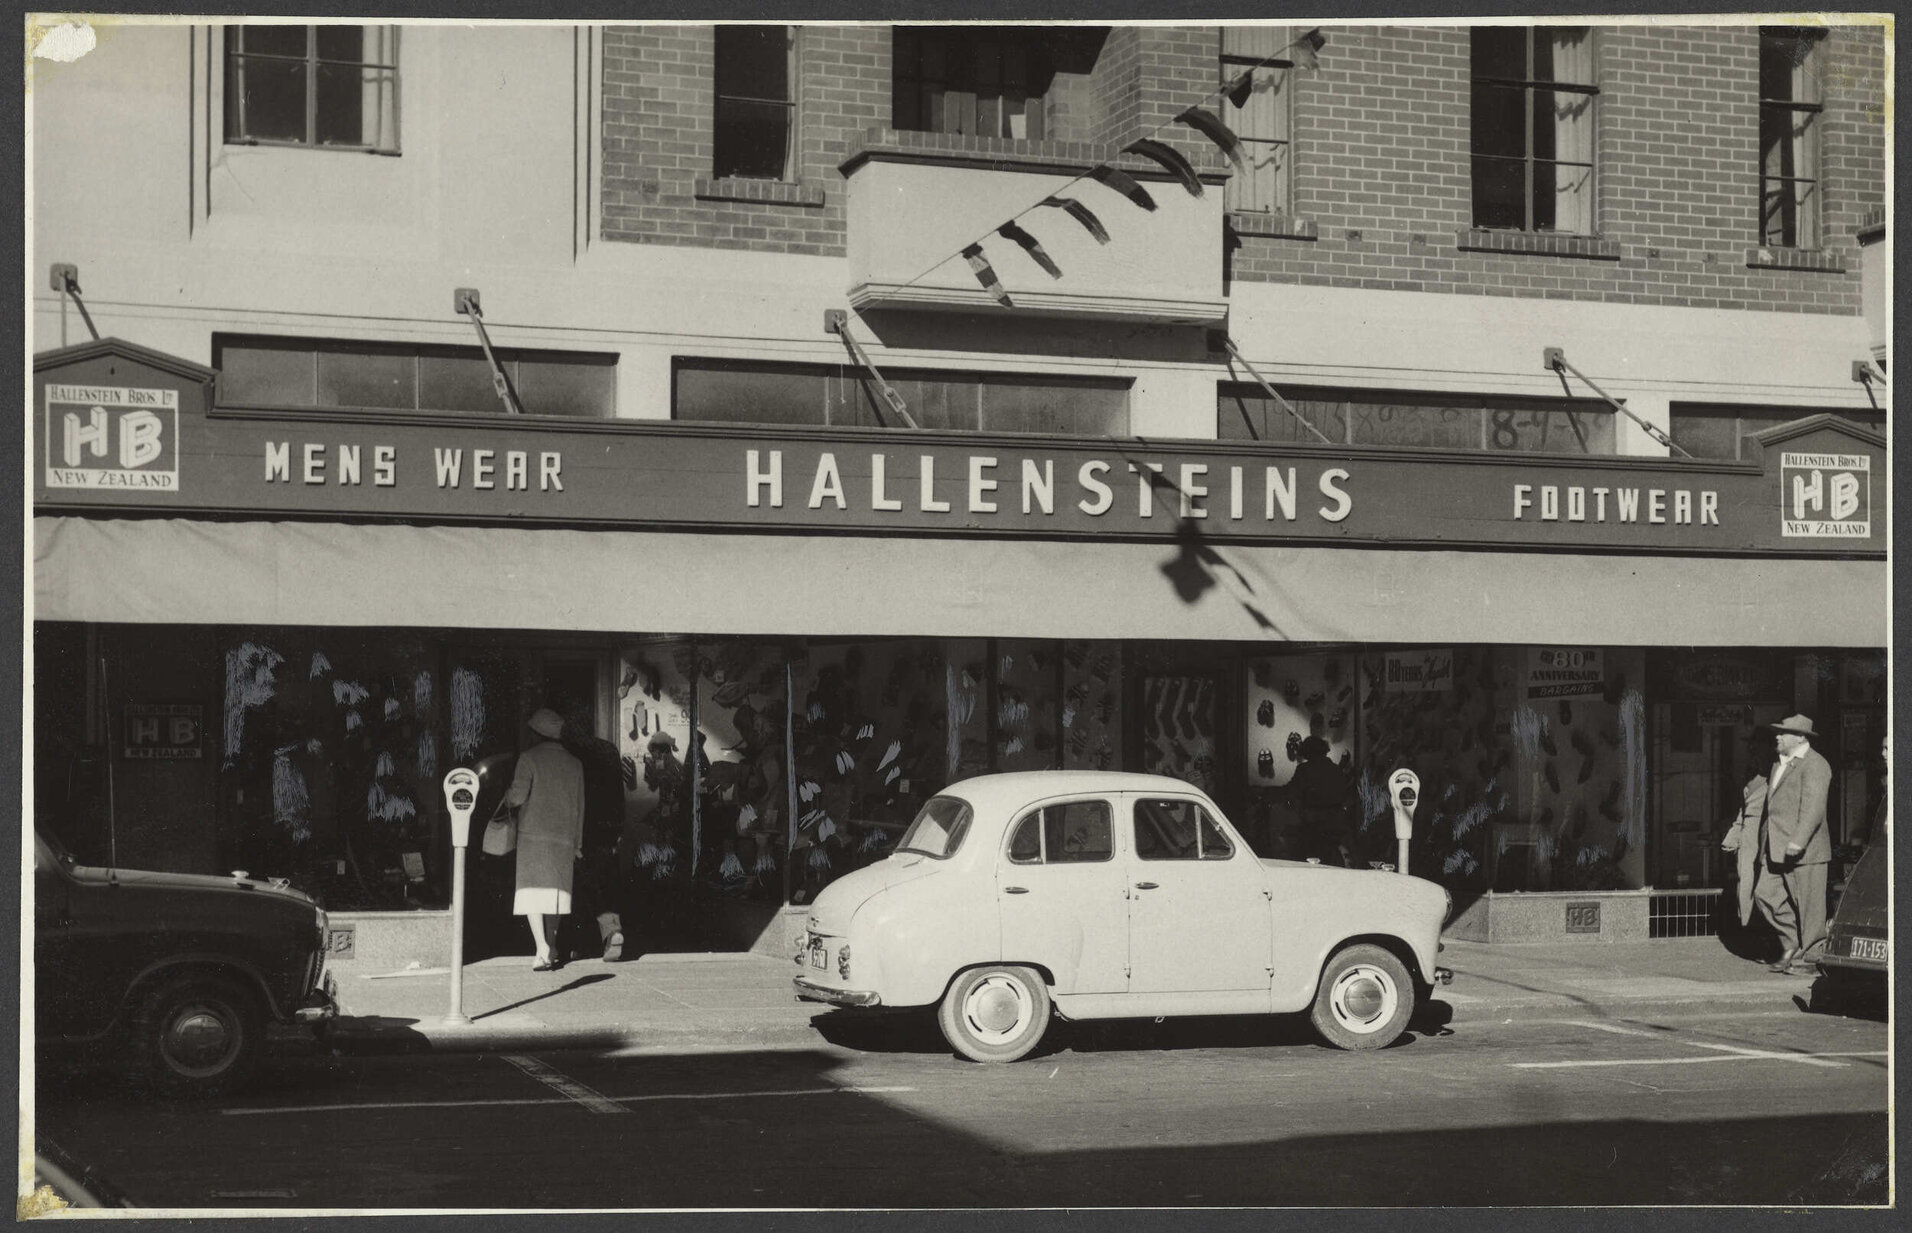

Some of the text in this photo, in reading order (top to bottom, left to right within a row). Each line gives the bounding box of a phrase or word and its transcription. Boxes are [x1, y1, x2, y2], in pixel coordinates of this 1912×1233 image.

[51, 385, 121, 403] HALLENSTEIN
[265, 441, 564, 491] MENS WEAR
[1785, 454, 1835, 467] HALLENSTEIN
[54, 470, 171, 488] NEW ZEALAND
[746, 449, 1352, 521] HALLENSTEINS
[1513, 484, 1719, 525] FOOTWEAR
[1787, 522, 1865, 535] NEW ZEALAND
[1530, 670, 1600, 681] ANNIVERSARY
[1539, 683, 1595, 696] BARGAINS
